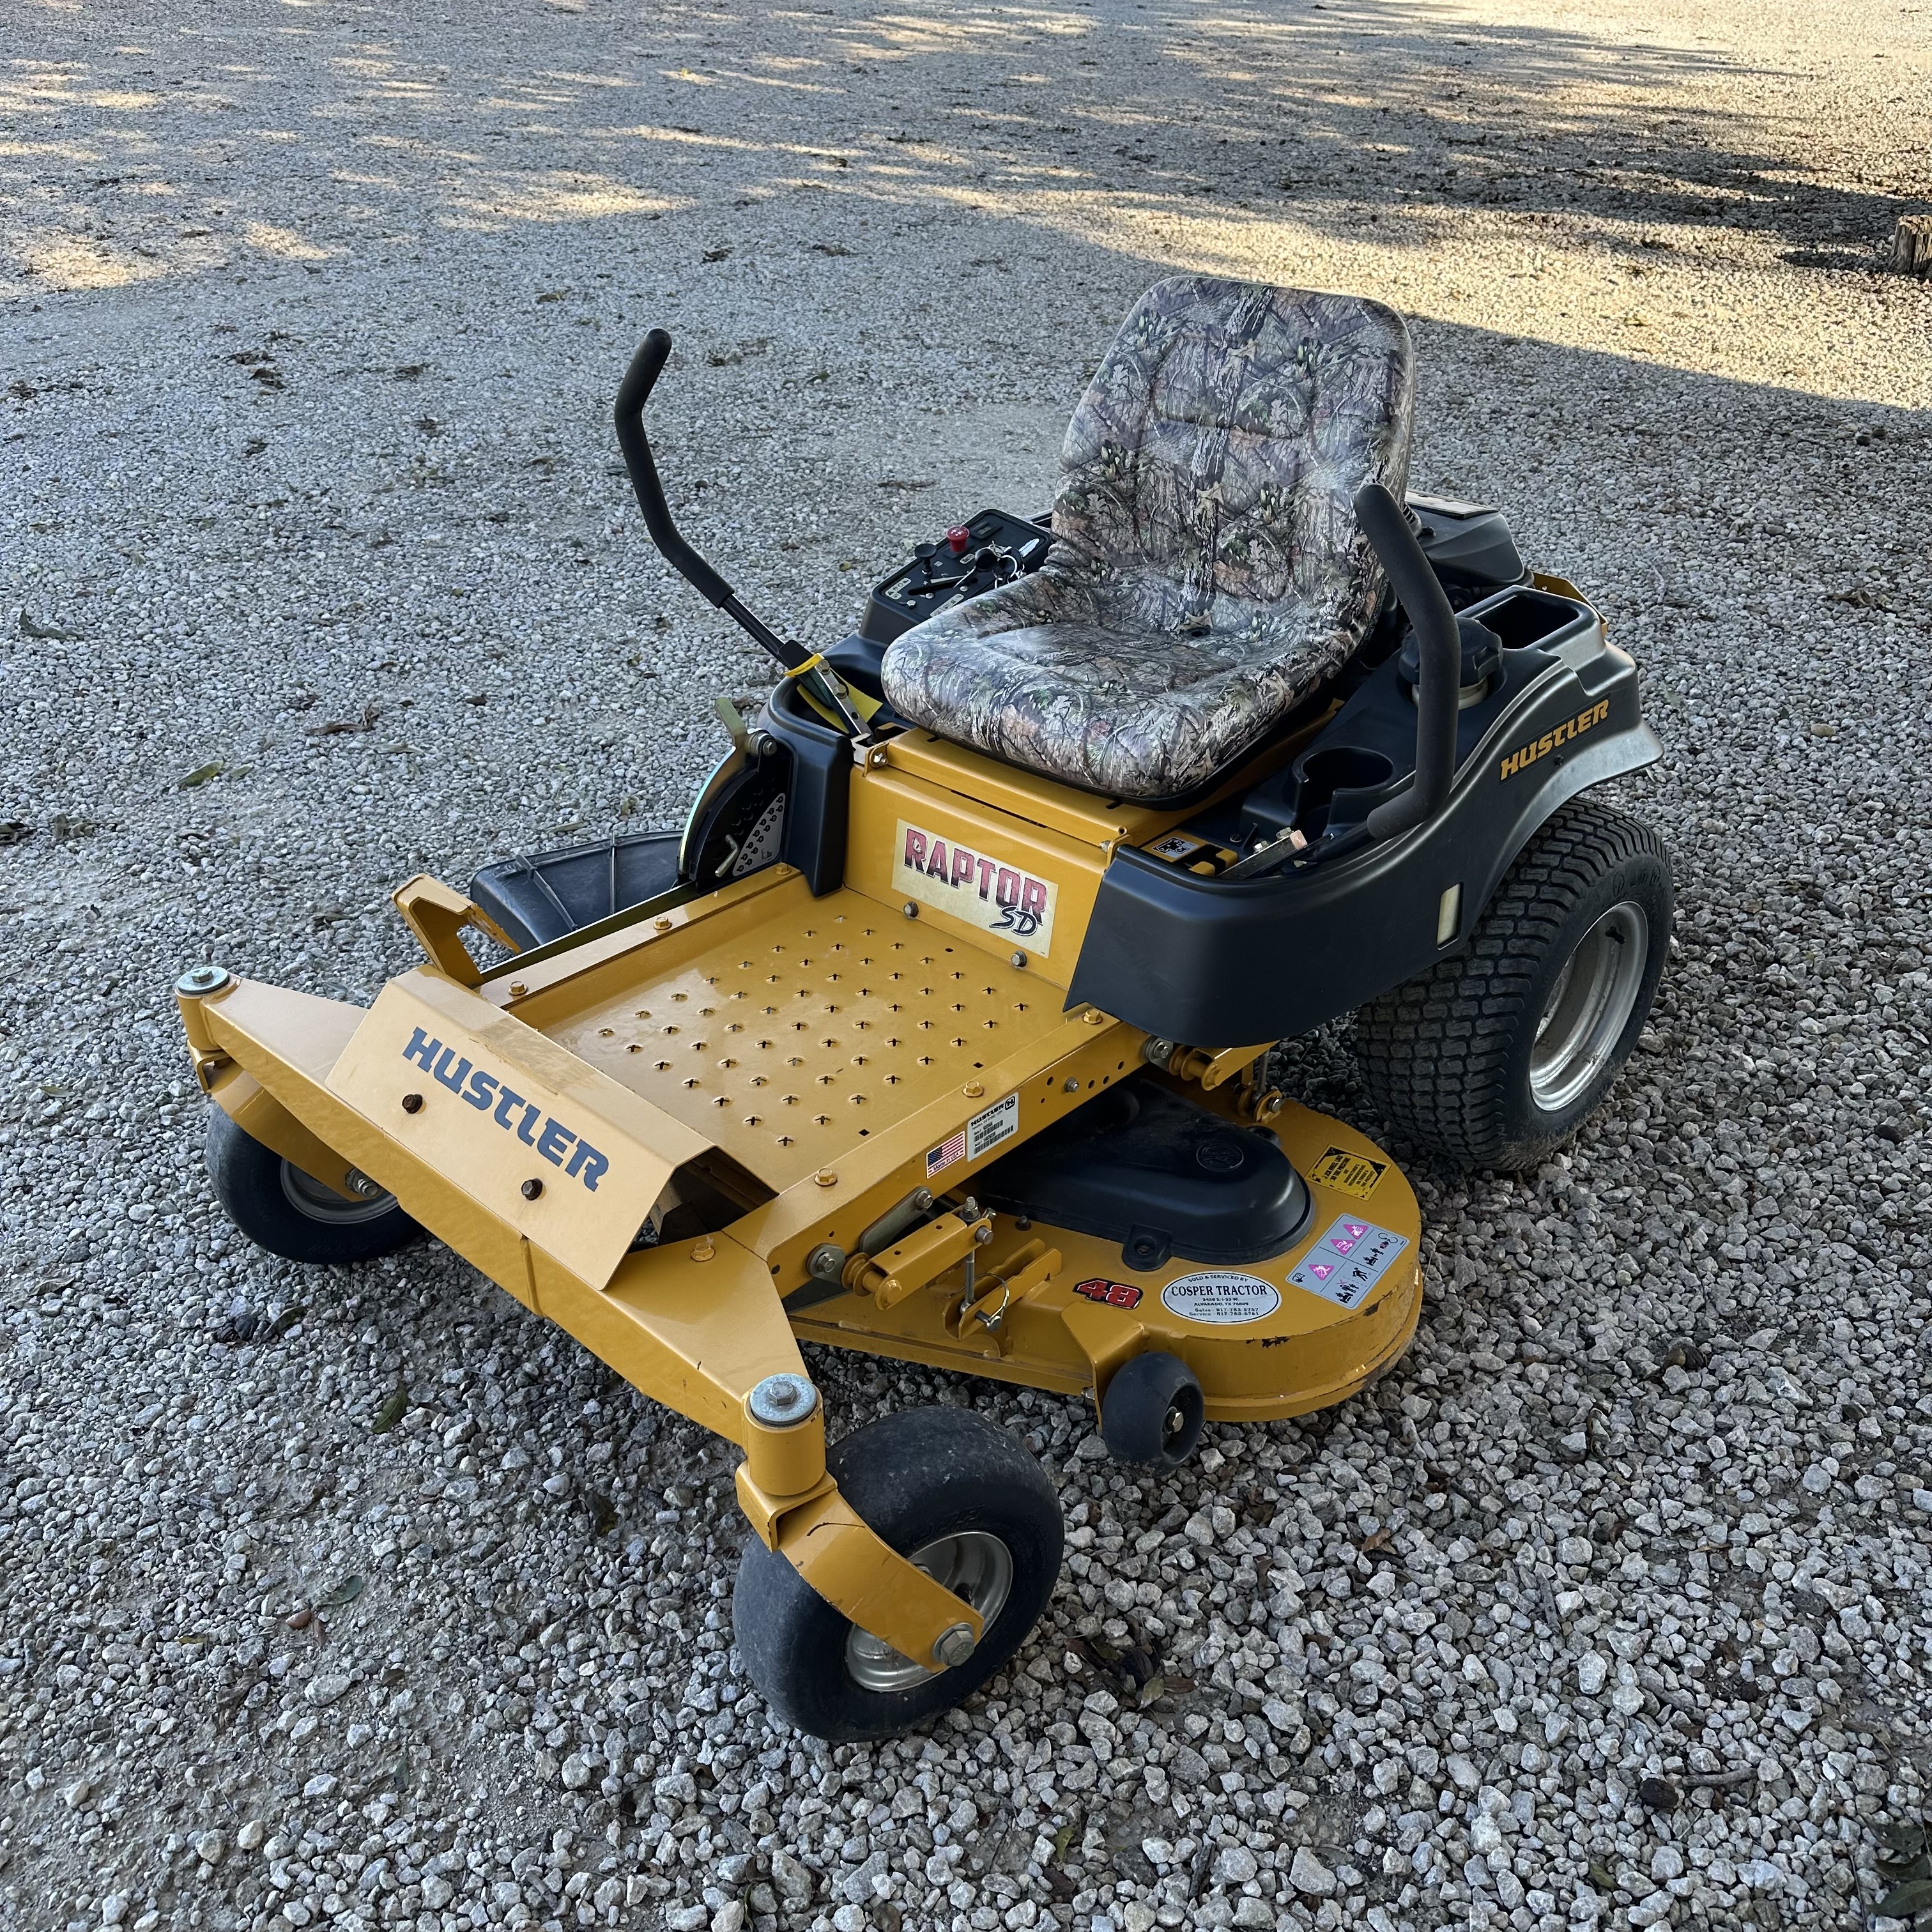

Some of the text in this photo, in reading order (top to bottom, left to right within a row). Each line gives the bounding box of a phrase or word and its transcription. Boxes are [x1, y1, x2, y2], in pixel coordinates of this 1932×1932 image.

[1500, 698, 1609, 781] HUSTLER
[903, 827, 1048, 926] RAPTOR
[989, 905, 1038, 937] SD
[402, 1026, 610, 1193] HUSTLER
[970, 1103, 1005, 1126] HUSTLER
[1073, 1278, 1142, 1310] 48
[1171, 1285, 1268, 1296] COSPER TRACTOR
